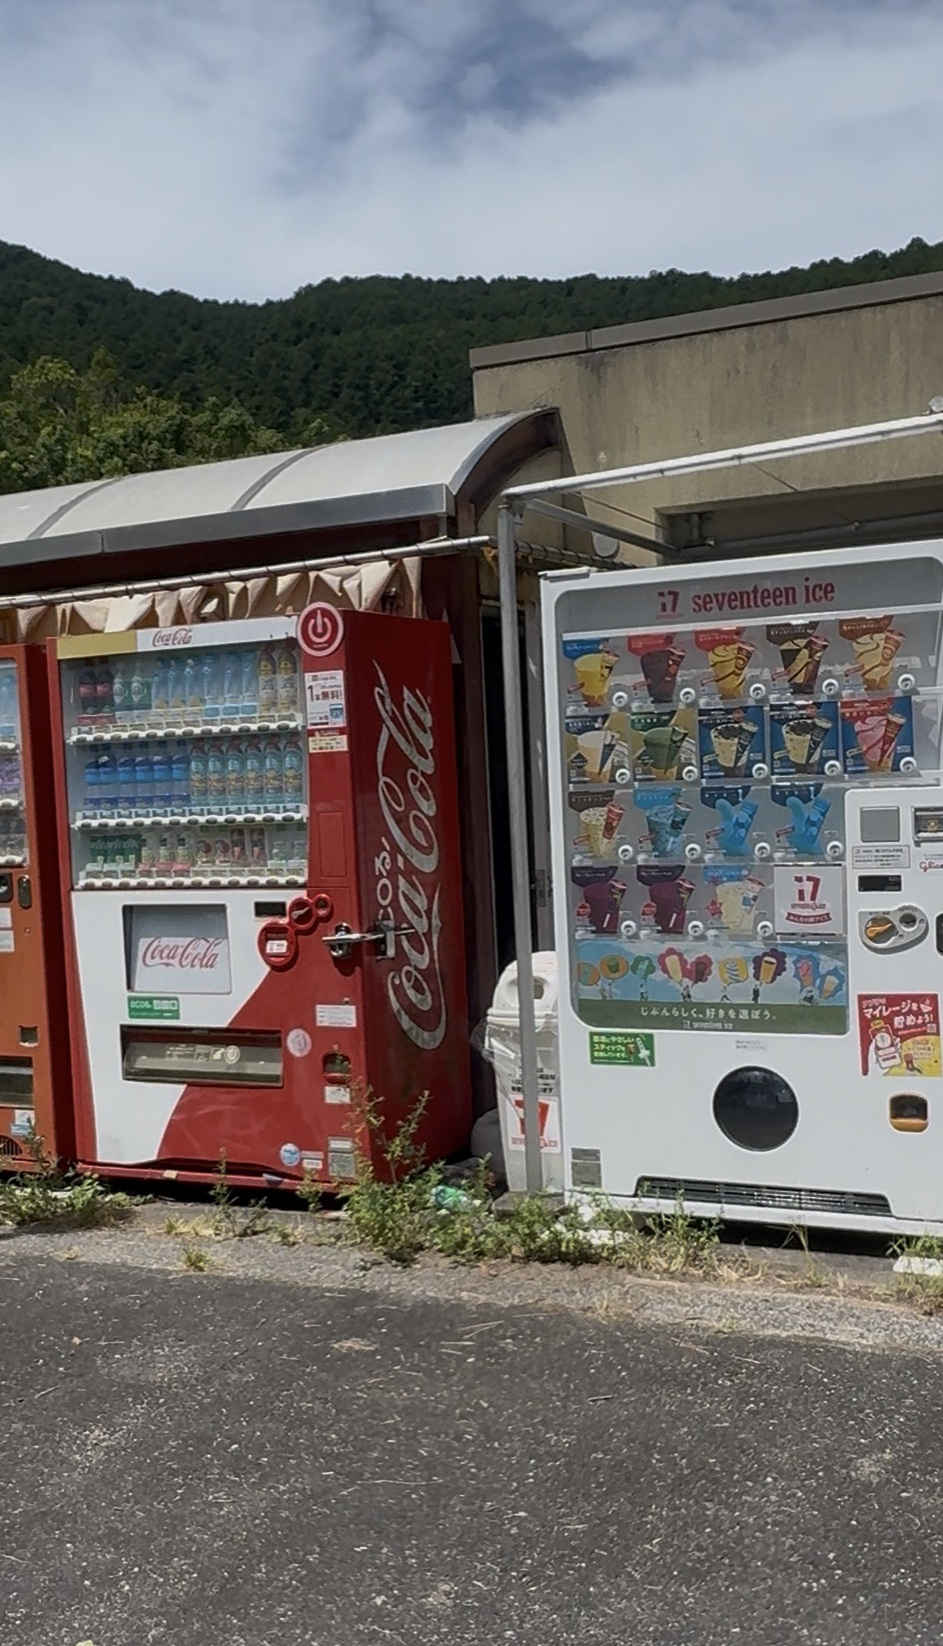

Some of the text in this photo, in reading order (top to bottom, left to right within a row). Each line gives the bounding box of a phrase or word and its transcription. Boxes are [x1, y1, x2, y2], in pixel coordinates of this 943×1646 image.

[692, 584, 797, 614] seventeen
[804, 576, 835, 604] ice
[142, 936, 222, 969] Coca-Cola
